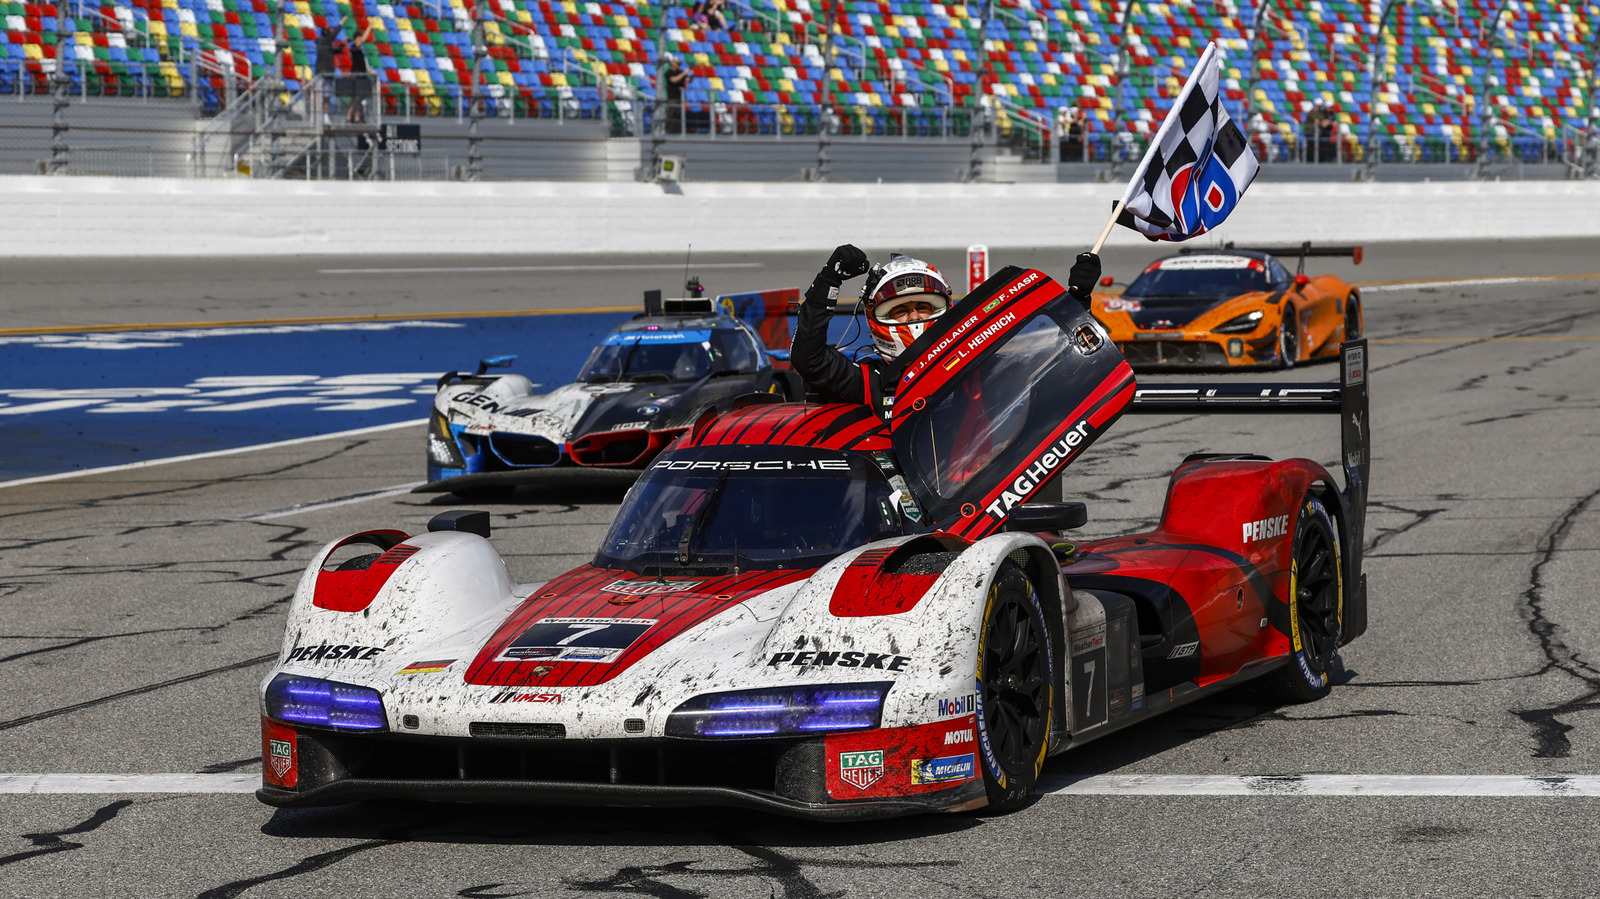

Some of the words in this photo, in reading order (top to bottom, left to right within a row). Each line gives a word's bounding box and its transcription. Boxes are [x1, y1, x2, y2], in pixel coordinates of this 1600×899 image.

[919, 361, 928, 369] J.
[927, 315, 979, 361] ANDLAUER
[998, 294, 1010, 302] F.
[1008, 272, 1039, 295] NASR
[958, 348, 970, 358] L.
[967, 311, 1016, 350] HEINRICH
[650, 459, 851, 471] PORSCHE
[1242, 514, 1290, 544] PENSKE
[556, 624, 612, 646] 7
[1073, 637, 1104, 653] WeatherTech
[284, 645, 386, 665] PENSKE
[767, 651, 911, 672] PENSKE
[1083, 660, 1096, 717] 7
[512, 693, 562, 704] IMSA
[938, 697, 966, 716] Mobil
[944, 729, 974, 745] MOTUL
[271, 742, 290, 755] TAG
[270, 756, 292, 773] HEUER
[844, 753, 881, 766] TAG
[935, 761, 972, 776] MICHELIN
[843, 767, 883, 785] HEUER
